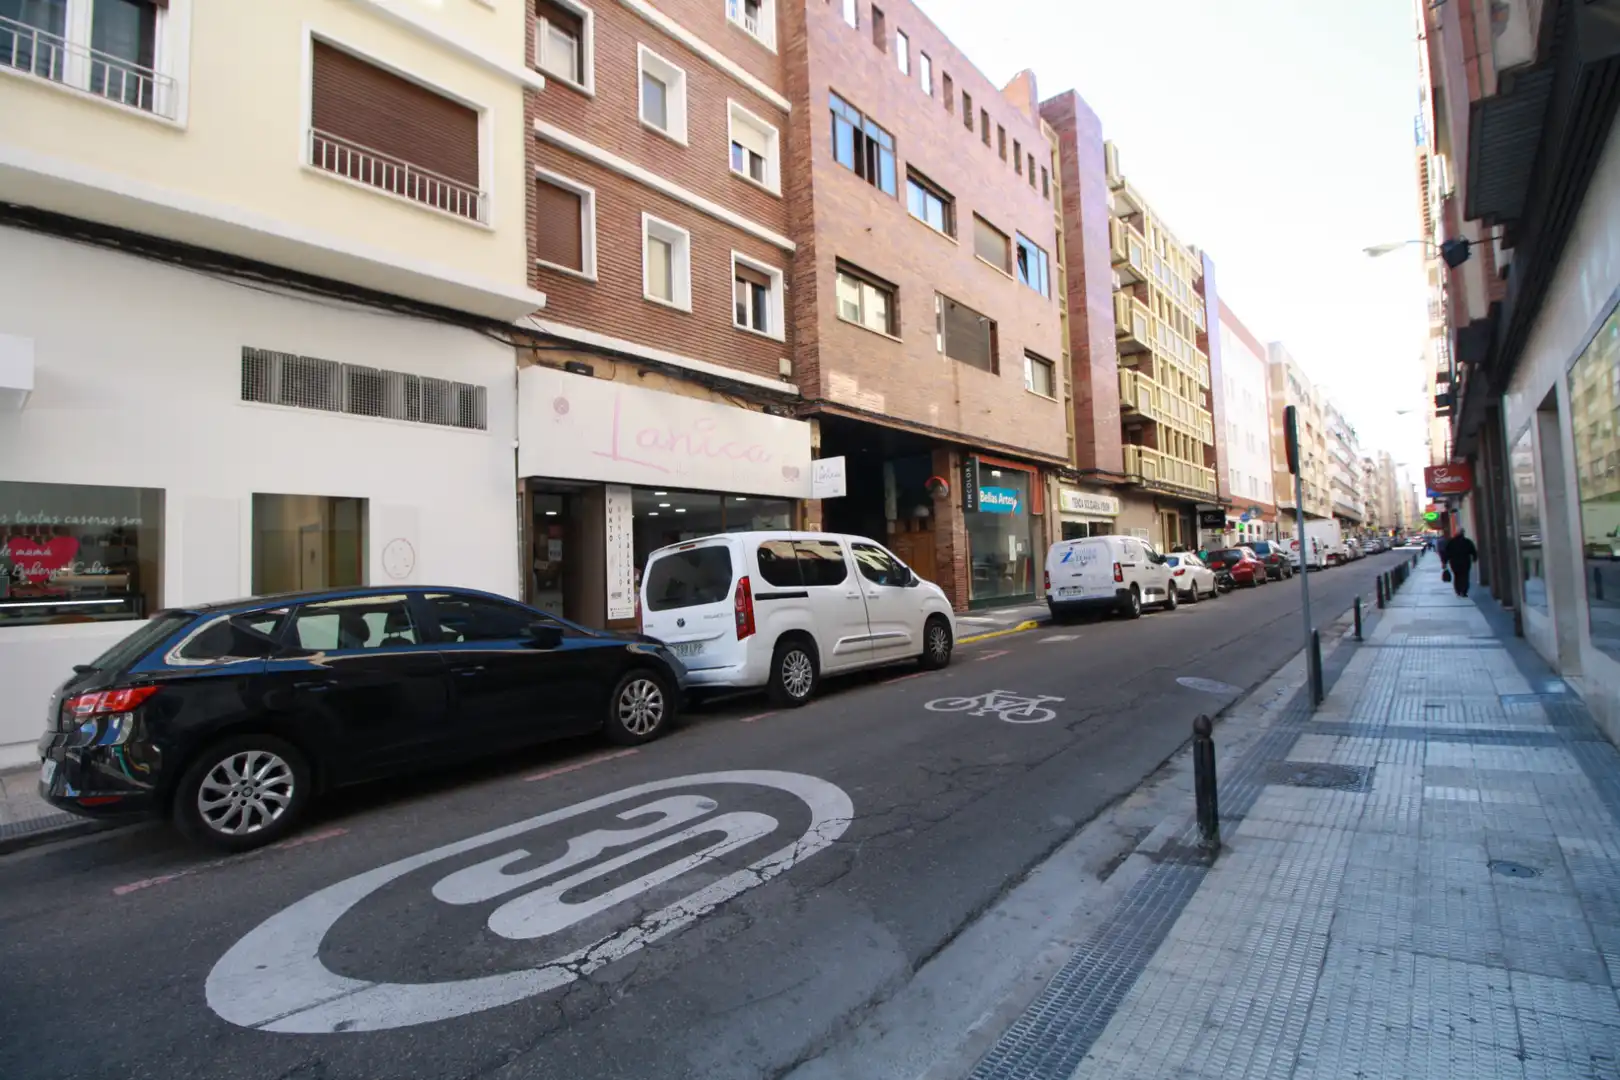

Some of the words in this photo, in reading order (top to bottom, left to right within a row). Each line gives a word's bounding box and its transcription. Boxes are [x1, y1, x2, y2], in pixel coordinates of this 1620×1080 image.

[980, 490, 998, 504] Bellas
[15, 510, 59, 524] tartas
[64, 515, 116, 526] caseras
[431, 795, 780, 940] 30
